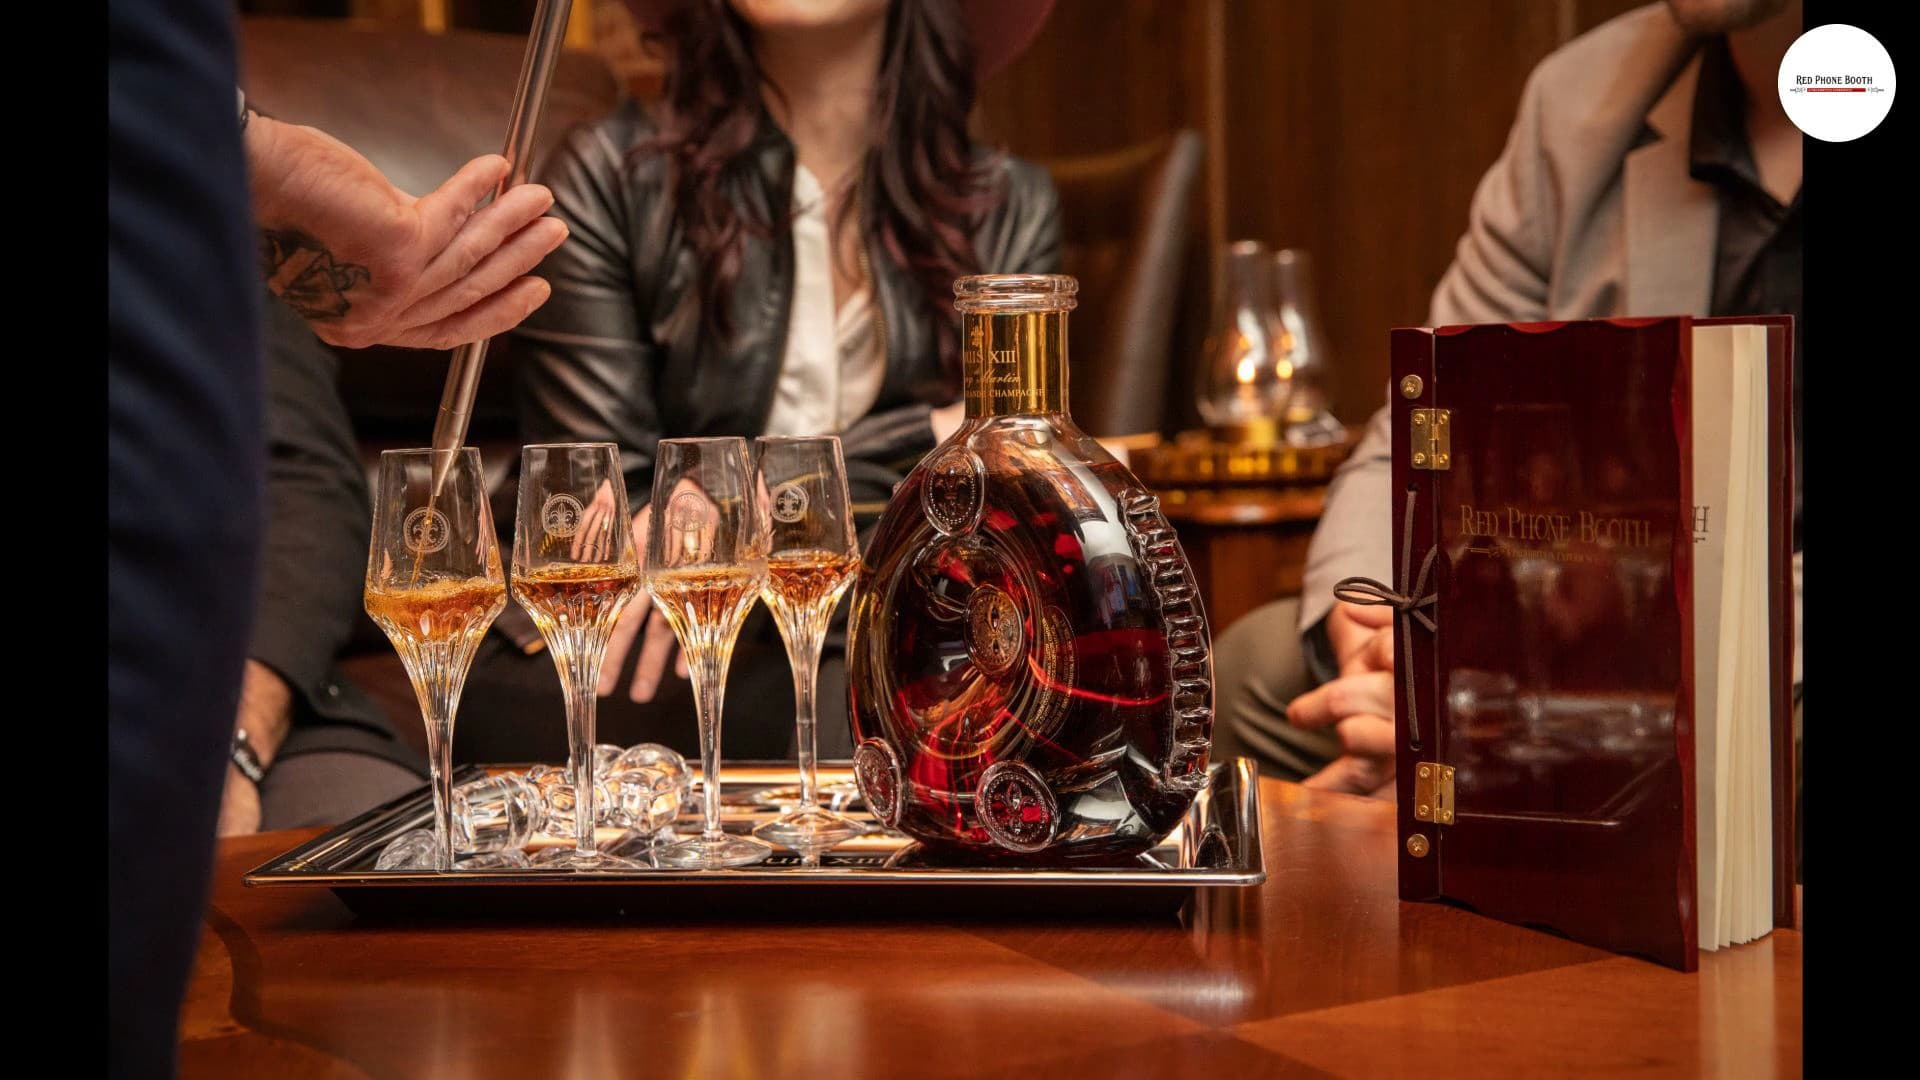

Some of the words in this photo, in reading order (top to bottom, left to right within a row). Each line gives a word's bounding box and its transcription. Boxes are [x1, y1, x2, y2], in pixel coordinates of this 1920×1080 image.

[989, 350, 1017, 364] XIII
[1460, 503, 1499, 537] RED
[1506, 505, 1571, 543] PHONE
[1579, 510, 1651, 547] BOOTH
